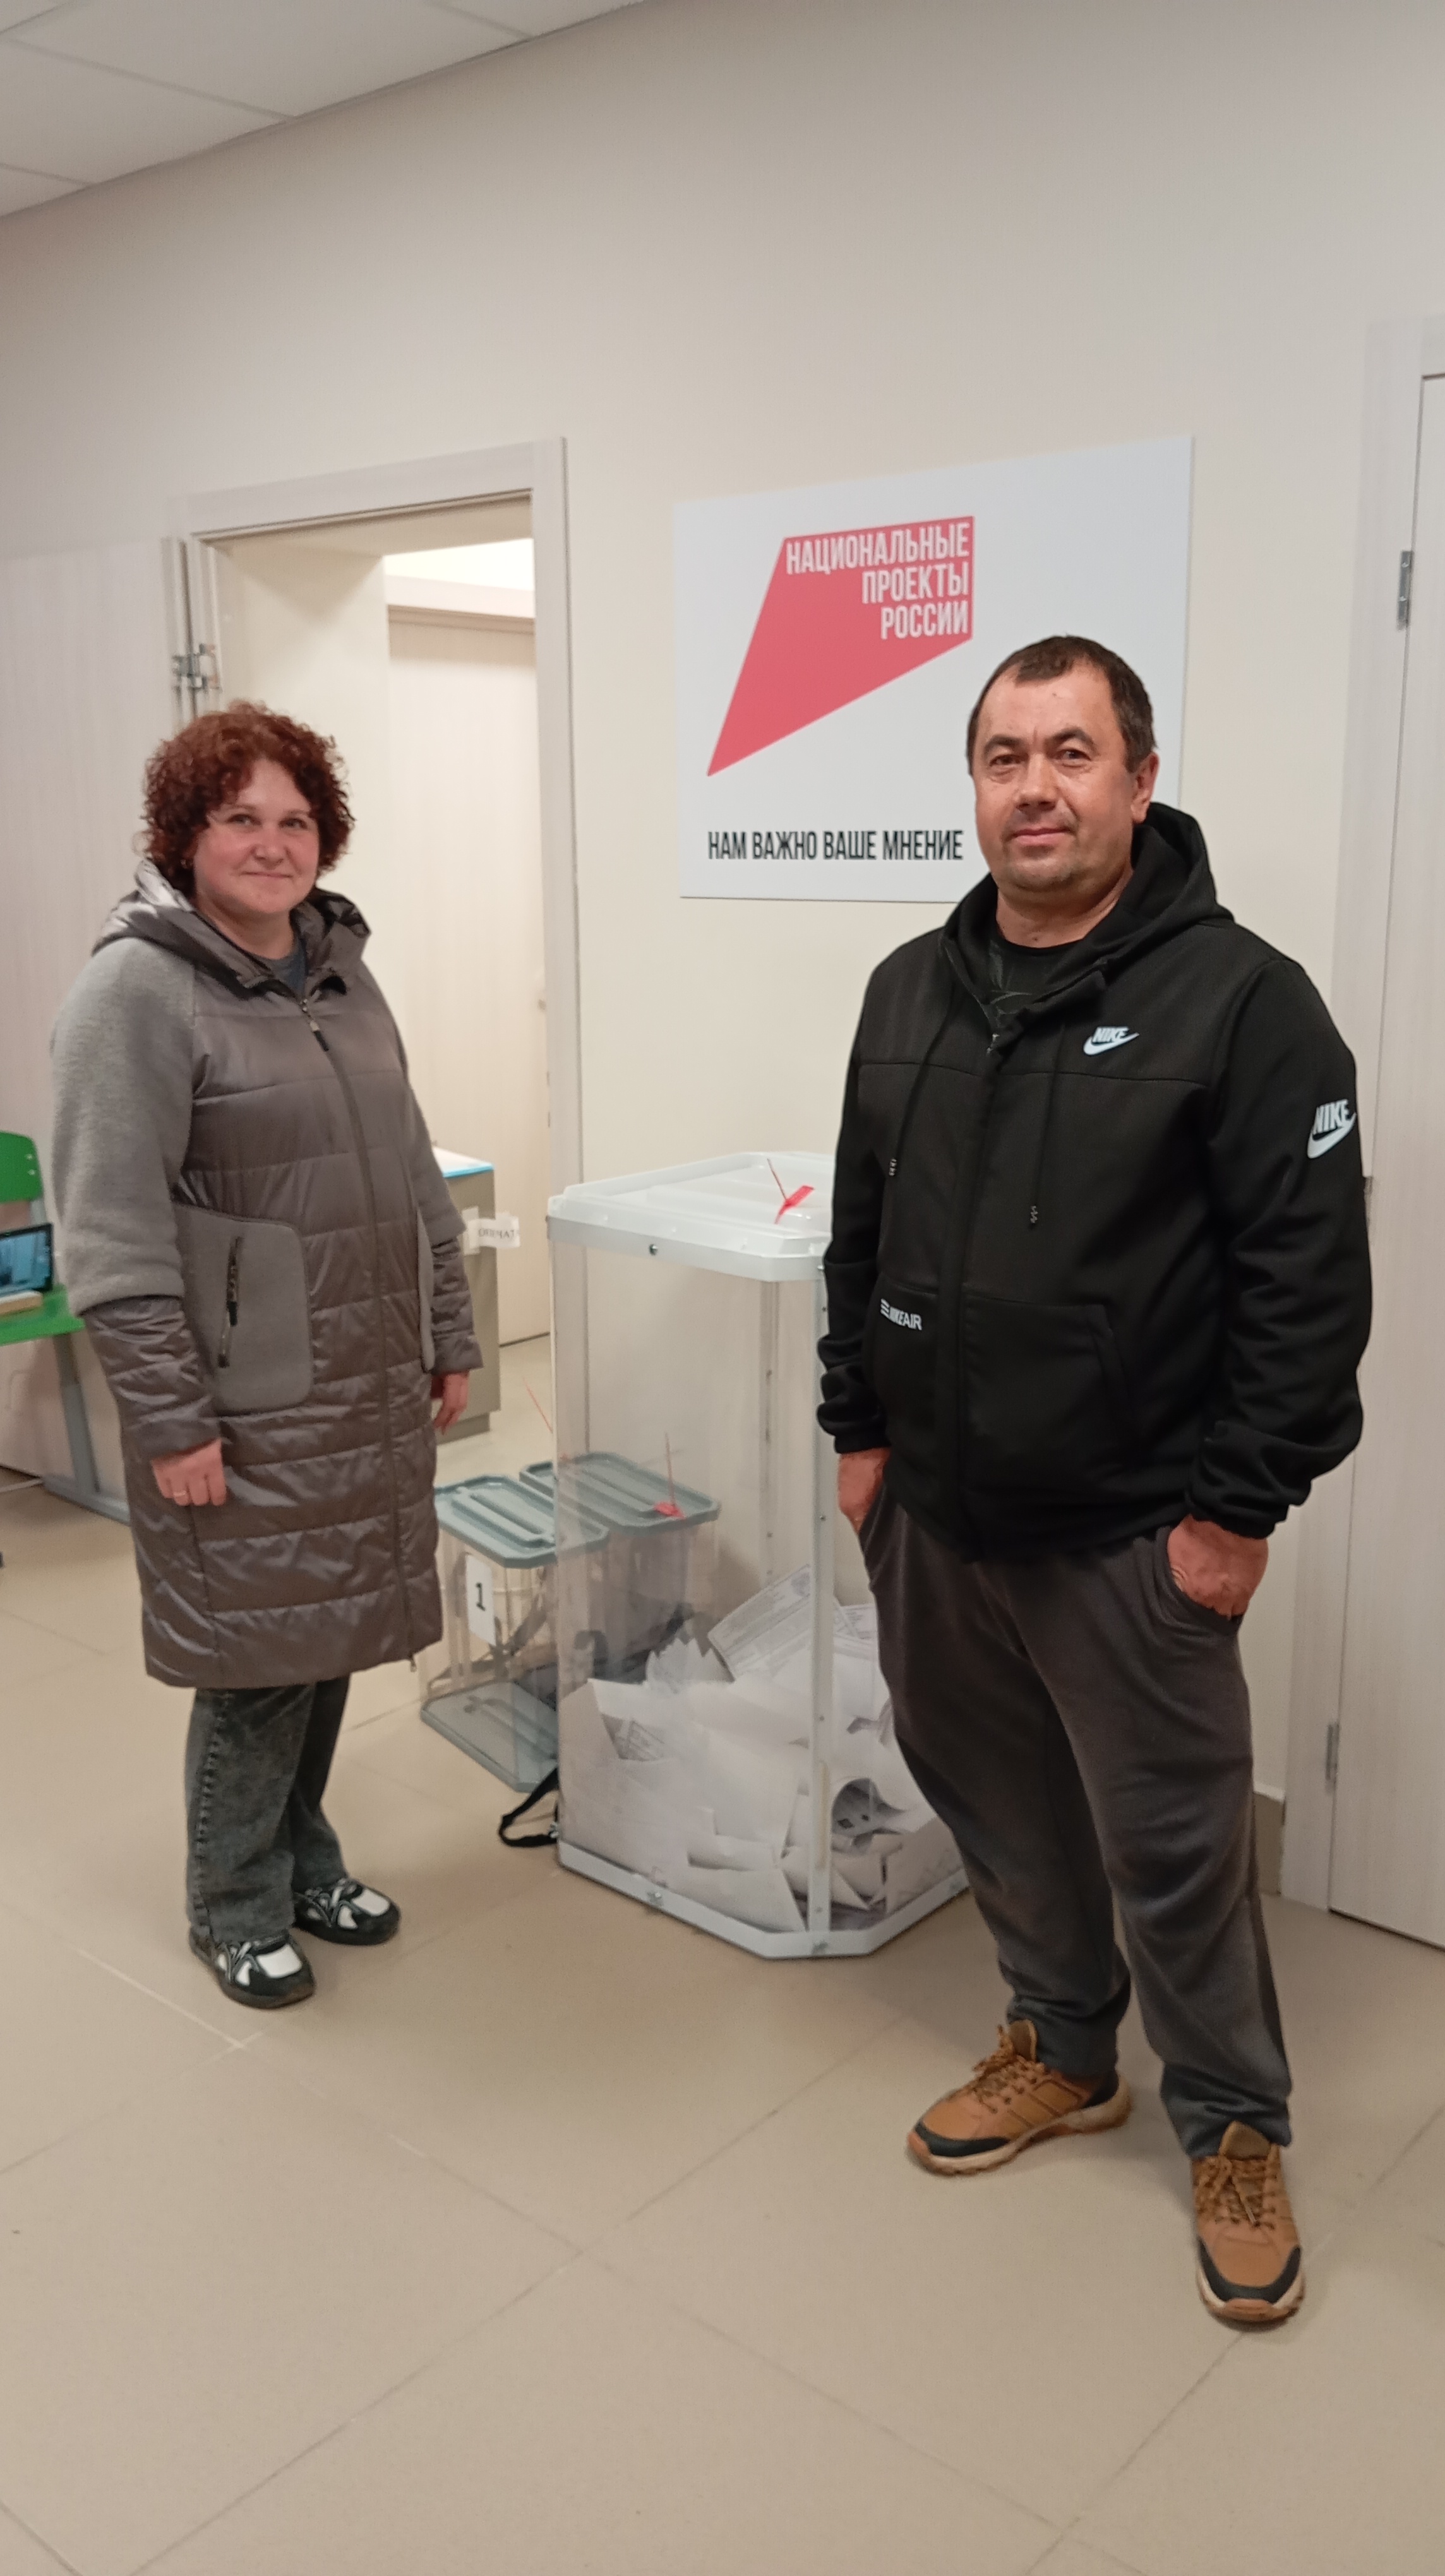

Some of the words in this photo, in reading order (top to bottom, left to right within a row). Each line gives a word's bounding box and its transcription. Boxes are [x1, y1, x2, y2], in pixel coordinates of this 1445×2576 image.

[786, 522, 970, 575] НАЦИОНАЛЬНЫЕ
[861, 561, 969, 604] ПРОЕКТЫ
[880, 600, 968, 640] РОССИИ
[708, 831, 747, 860] НАМ
[752, 830, 818, 860] ВАЖНО
[823, 830, 877, 860] ВАШЕ
[883, 830, 964, 860] МНЕНИЕ
[1091, 1026, 1129, 1042] NIKE
[1312, 1099, 1349, 1135] NIKE
[476, 1582, 486, 1611] 1
